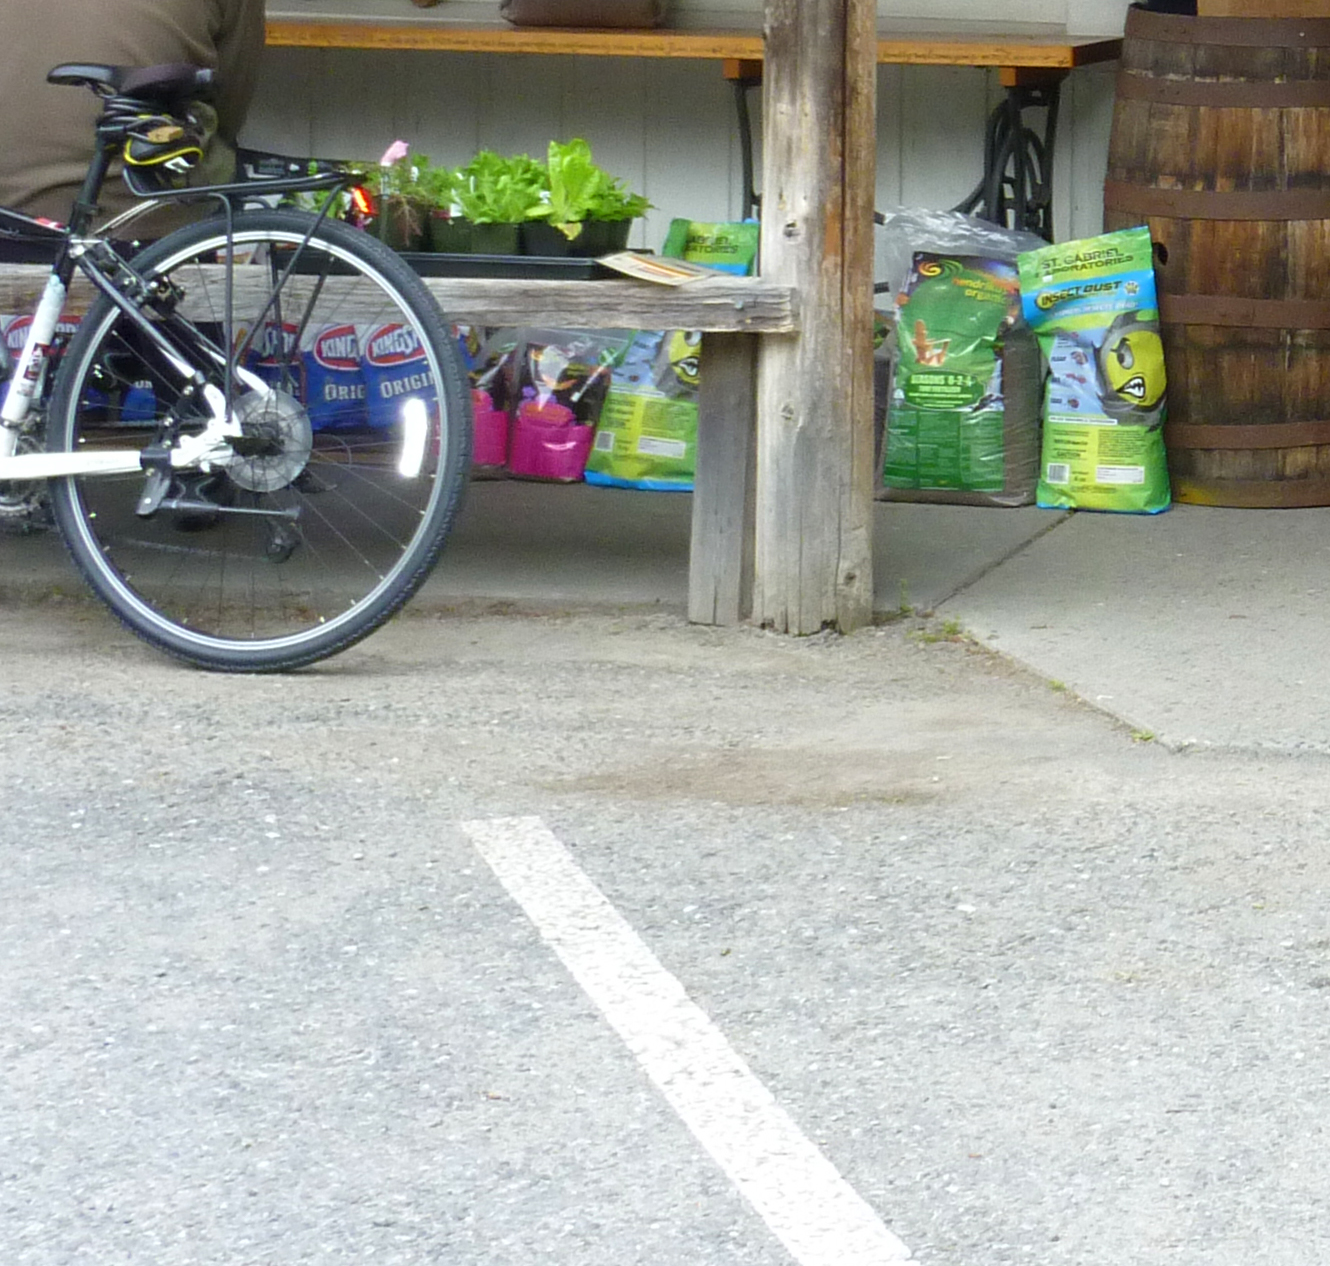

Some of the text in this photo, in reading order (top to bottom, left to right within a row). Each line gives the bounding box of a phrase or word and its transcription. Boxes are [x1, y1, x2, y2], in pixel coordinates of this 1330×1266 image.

[1064, 247, 1125, 265] GABRIEL
[1041, 281, 1123, 306] INSECT DUST
